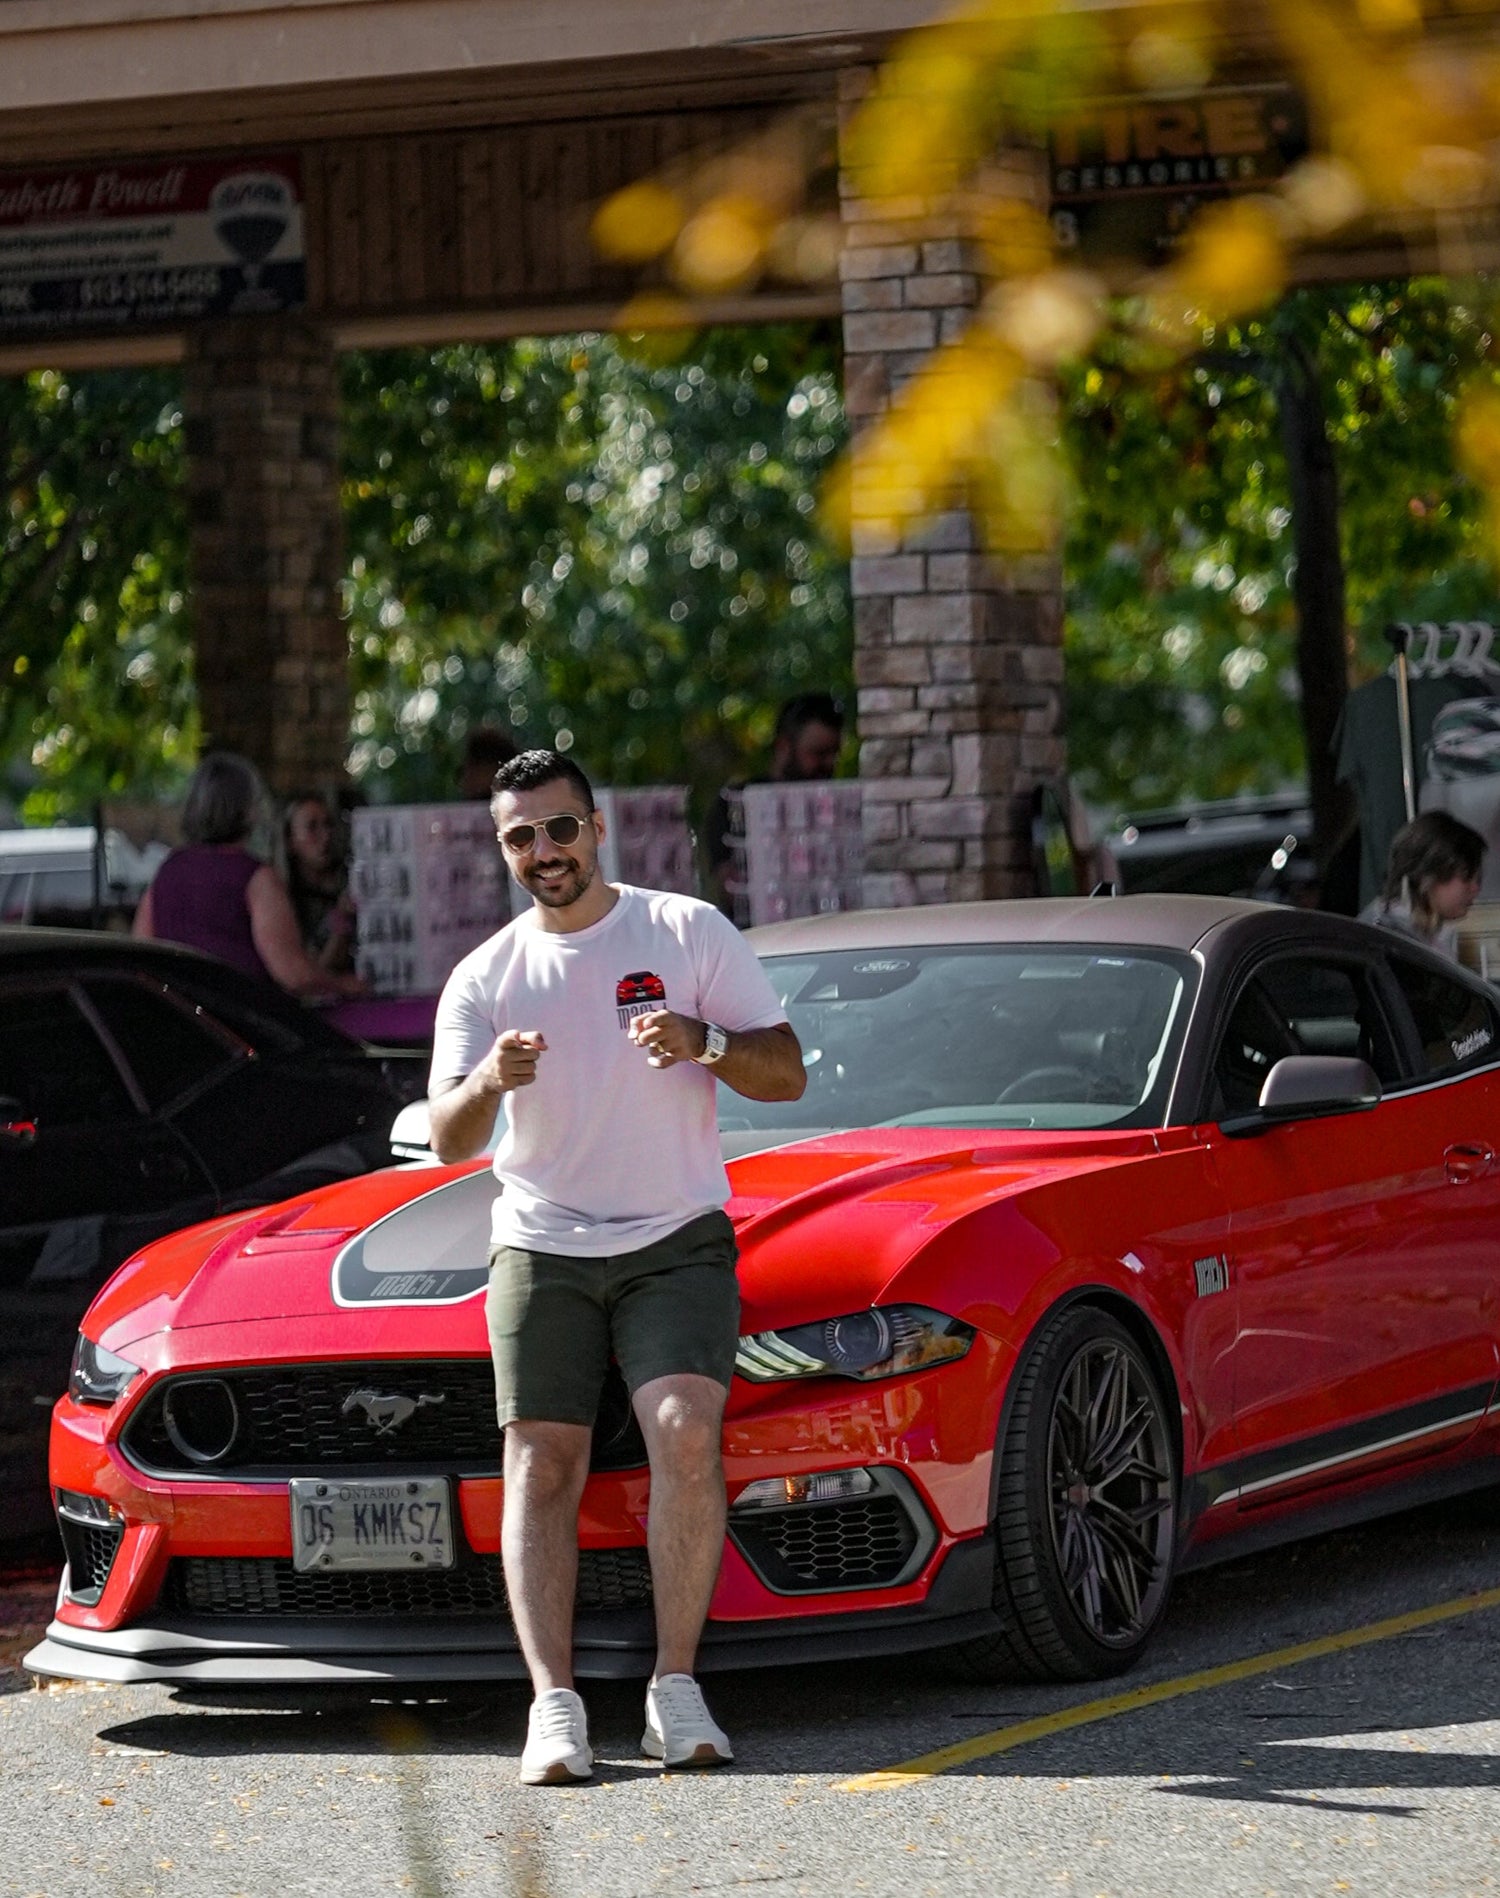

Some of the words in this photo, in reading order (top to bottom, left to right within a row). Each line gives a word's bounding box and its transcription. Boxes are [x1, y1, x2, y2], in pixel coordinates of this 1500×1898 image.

[89, 167, 188, 214] Powell
[339, 1486, 400, 1501] ONTARIO
[353, 1502, 443, 1545] KMKSZ
